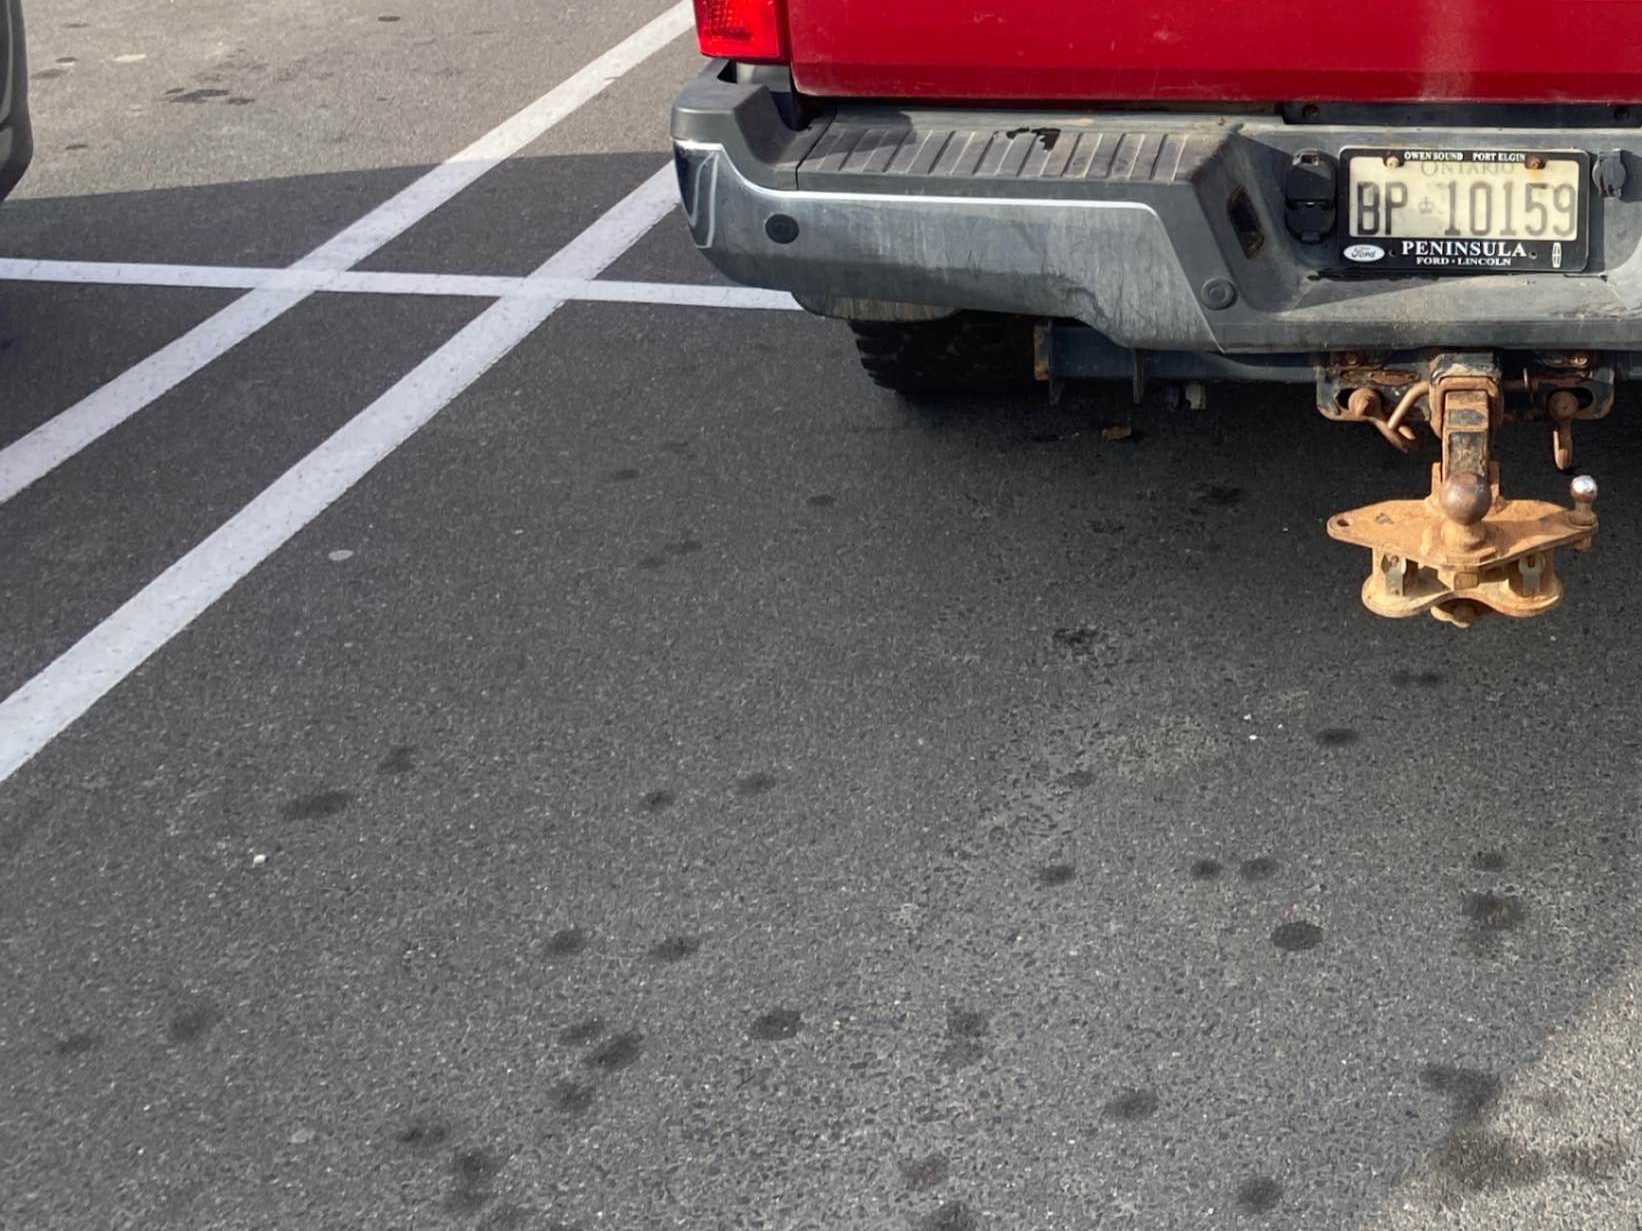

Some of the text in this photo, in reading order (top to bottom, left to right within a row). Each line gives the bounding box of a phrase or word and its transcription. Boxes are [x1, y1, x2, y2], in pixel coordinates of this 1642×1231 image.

[1404, 151, 1526, 162] OWEN SOUND PORT ELGIN
[1356, 181, 1577, 237] BP 10159
[1402, 240, 1527, 258] PENINSULA
[1416, 257, 1512, 267] FORD LINCOLN
